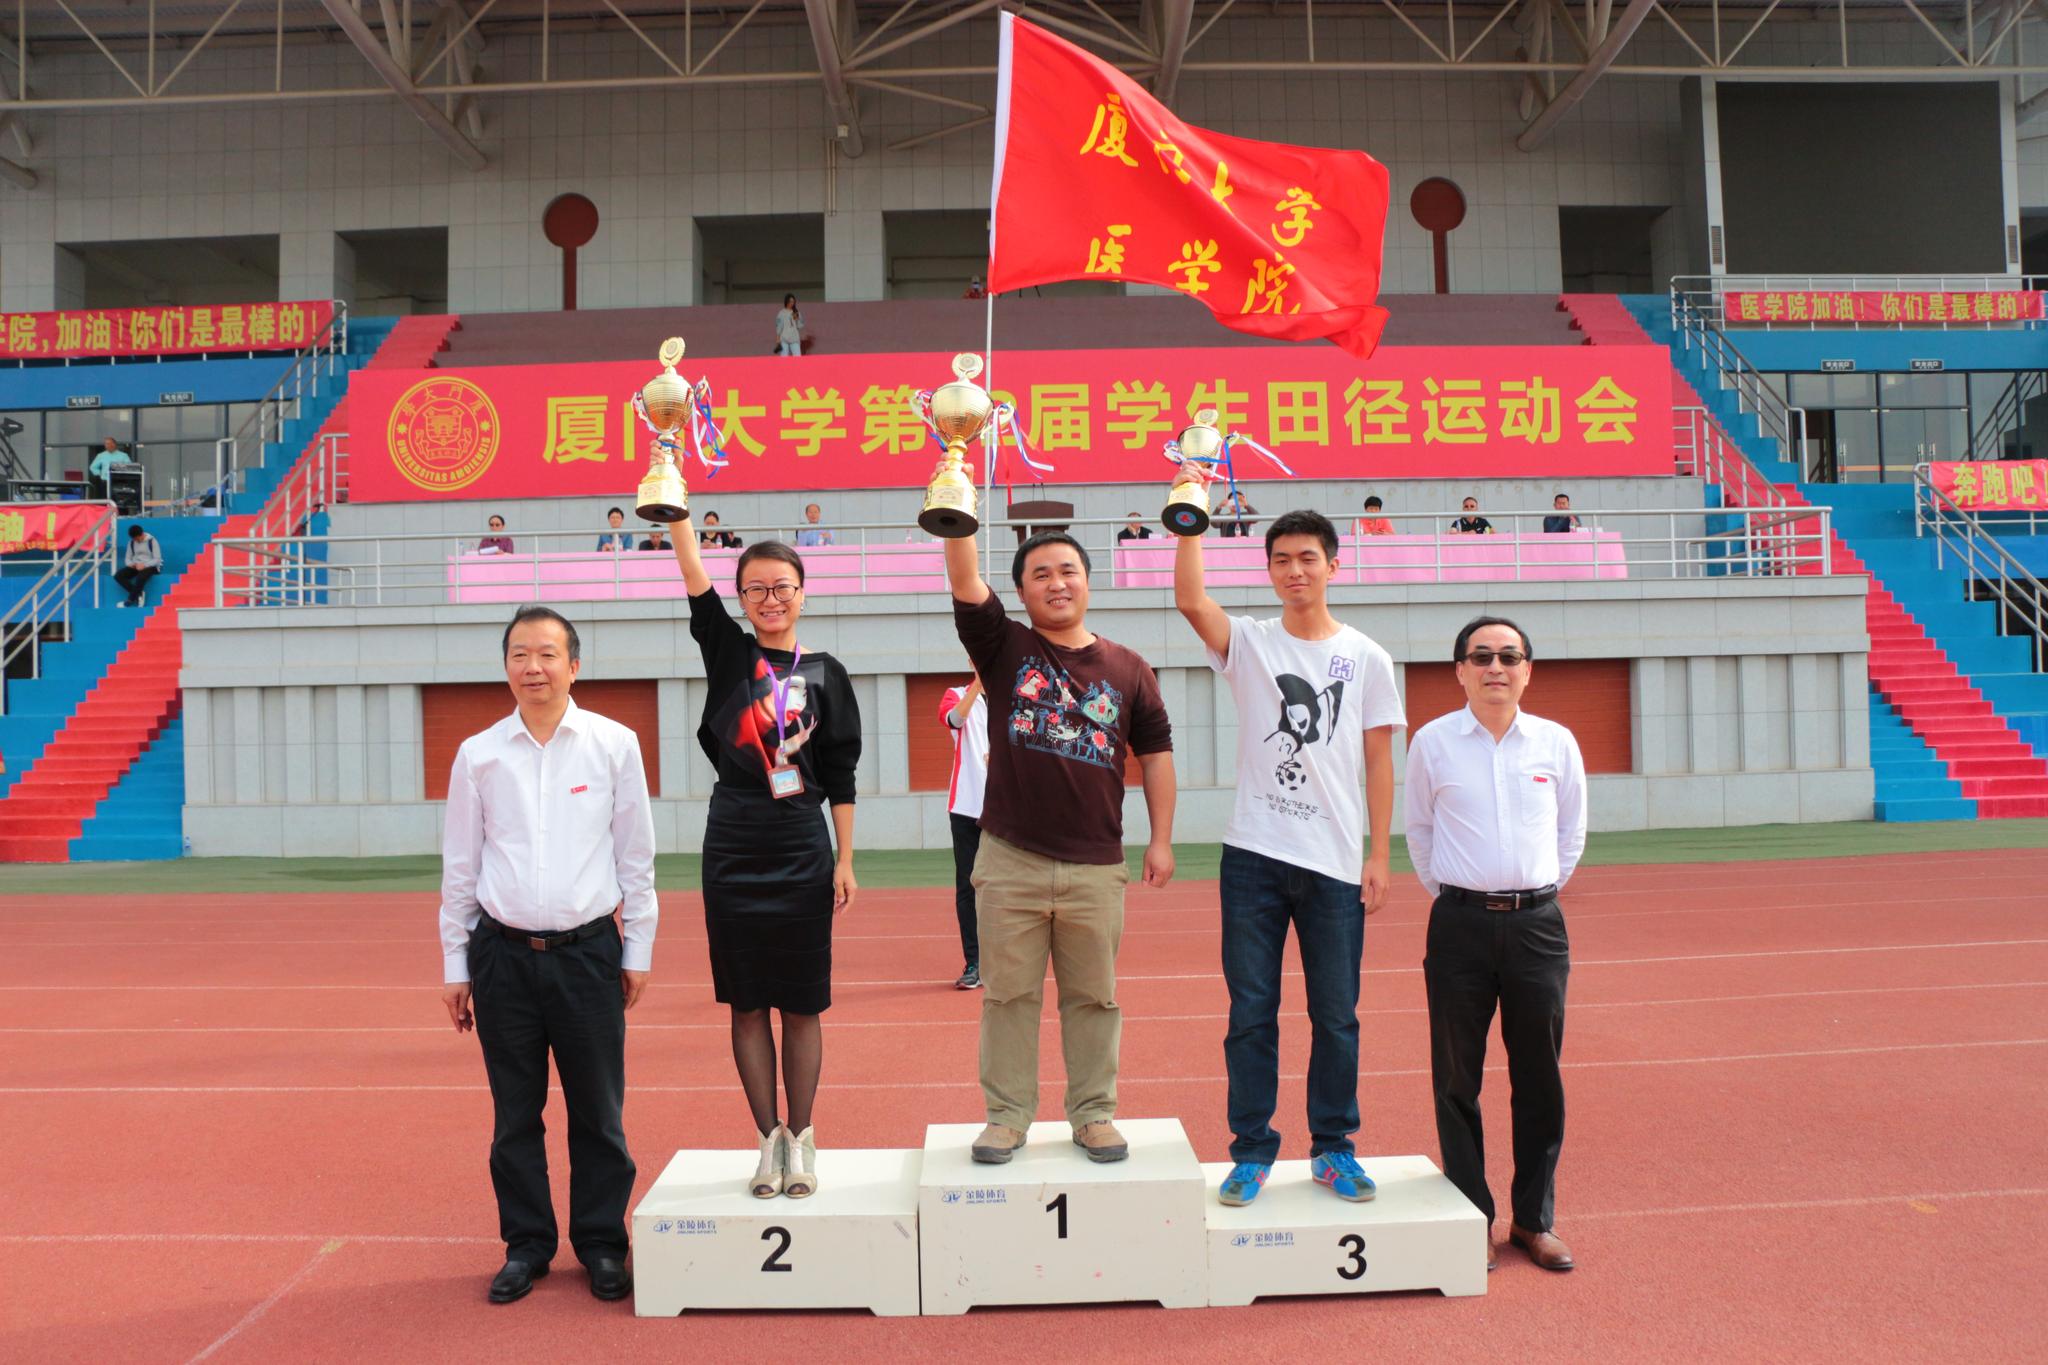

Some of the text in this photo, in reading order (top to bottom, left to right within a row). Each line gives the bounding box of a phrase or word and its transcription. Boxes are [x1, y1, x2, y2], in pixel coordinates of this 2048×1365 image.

[1953, 463, 2048, 507] 奔跑吧
[1329, 655, 1356, 682] 23
[1046, 1193, 1068, 1239] 1
[761, 1226, 793, 1272] 2
[1336, 1234, 1368, 1280] 3
